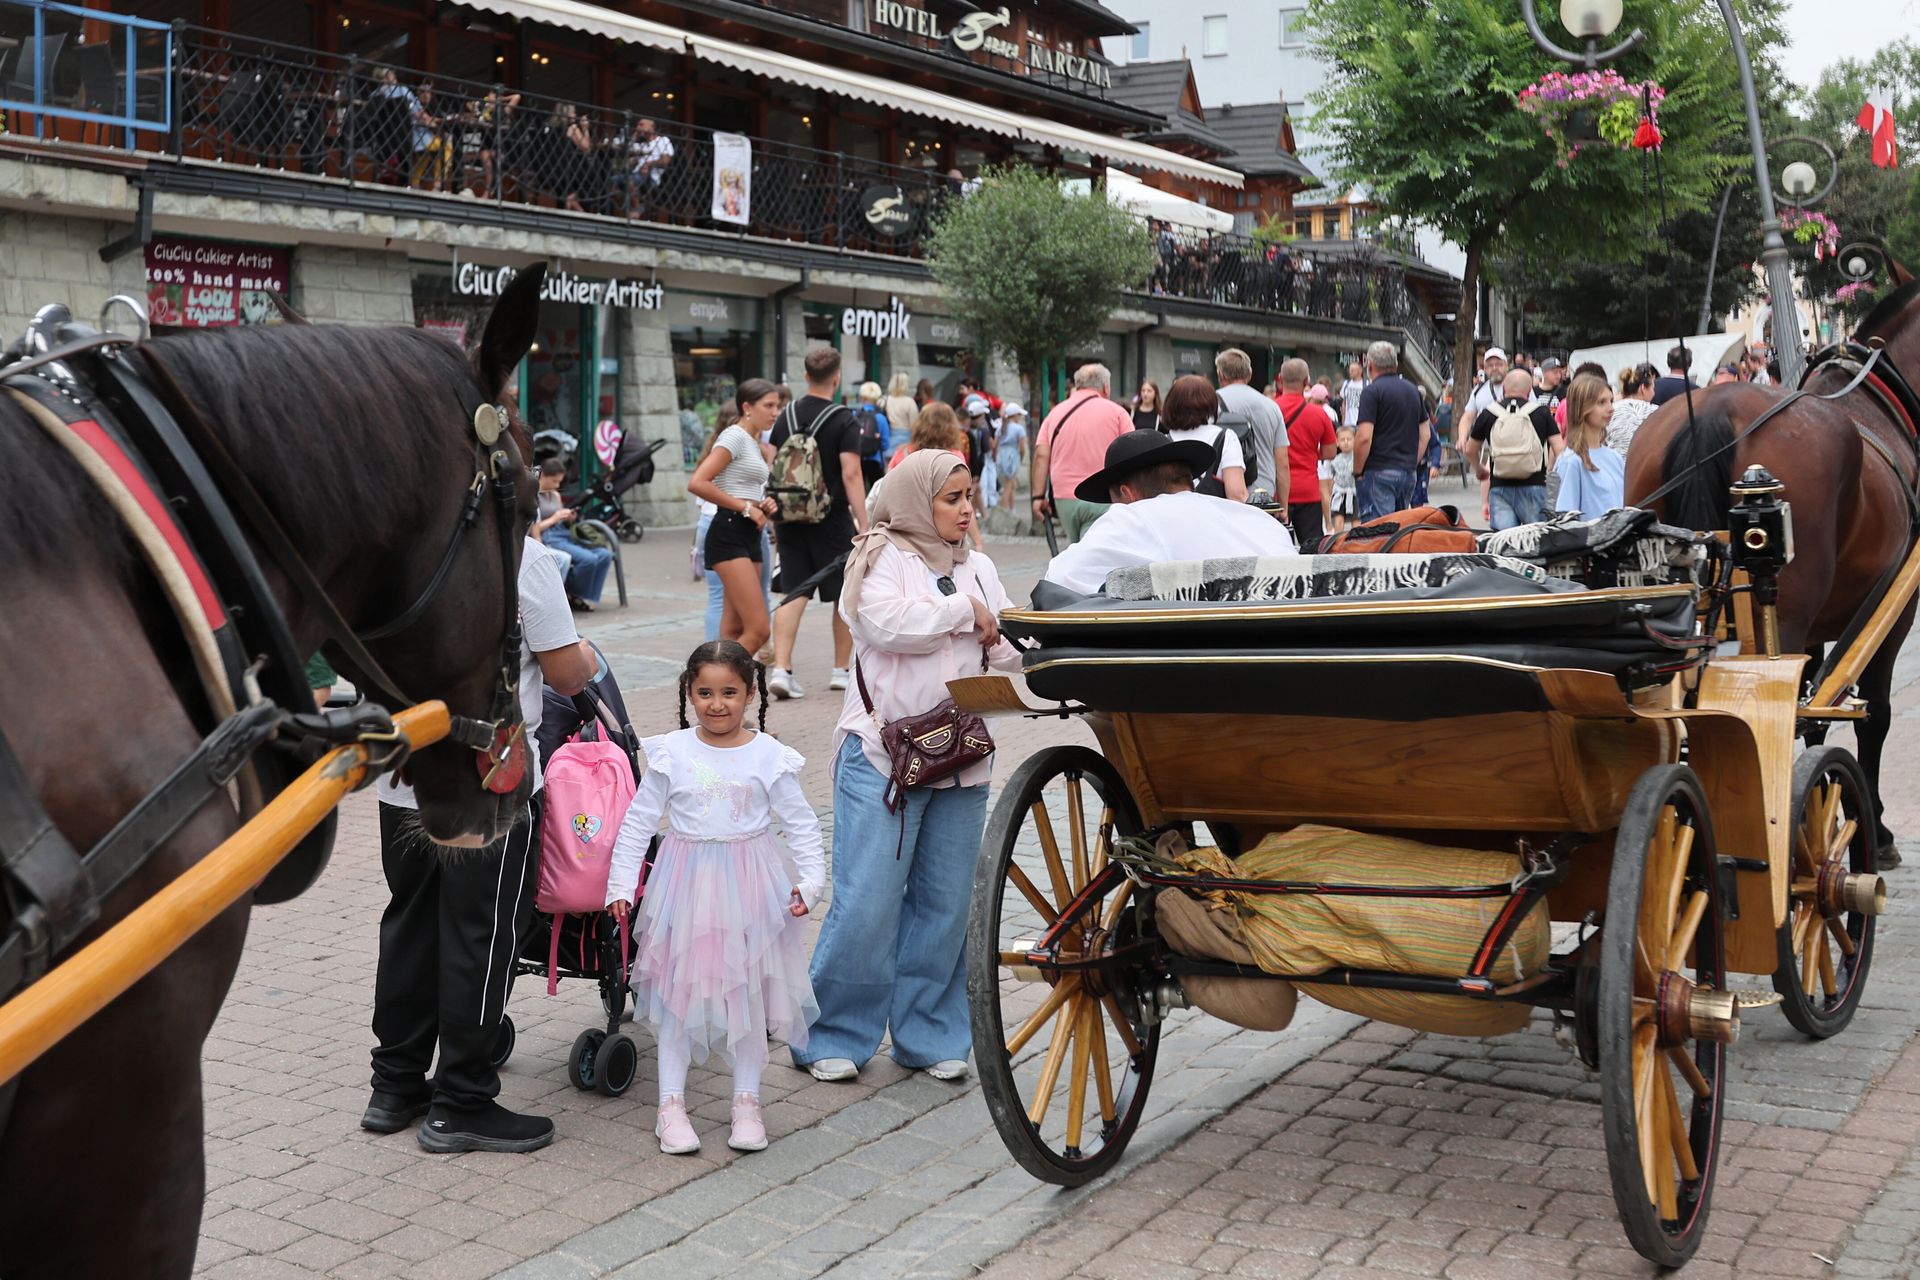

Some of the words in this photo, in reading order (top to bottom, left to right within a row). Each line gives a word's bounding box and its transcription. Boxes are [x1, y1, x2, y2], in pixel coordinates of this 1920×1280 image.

[875, 0, 942, 39] HOTEL
[1029, 43, 1112, 89] KARCZMA
[154, 244, 192, 263] CiuCiu
[195, 247, 234, 266] Cukier
[237, 252, 273, 269] Artist
[145, 267, 185, 284] 100%
[192, 270, 233, 287] hand
[240, 277, 281, 291] made
[458, 262, 493, 296] Ciu
[604, 278, 664, 311] Artist
[690, 298, 728, 321] empik
[842, 296, 910, 345] empik
